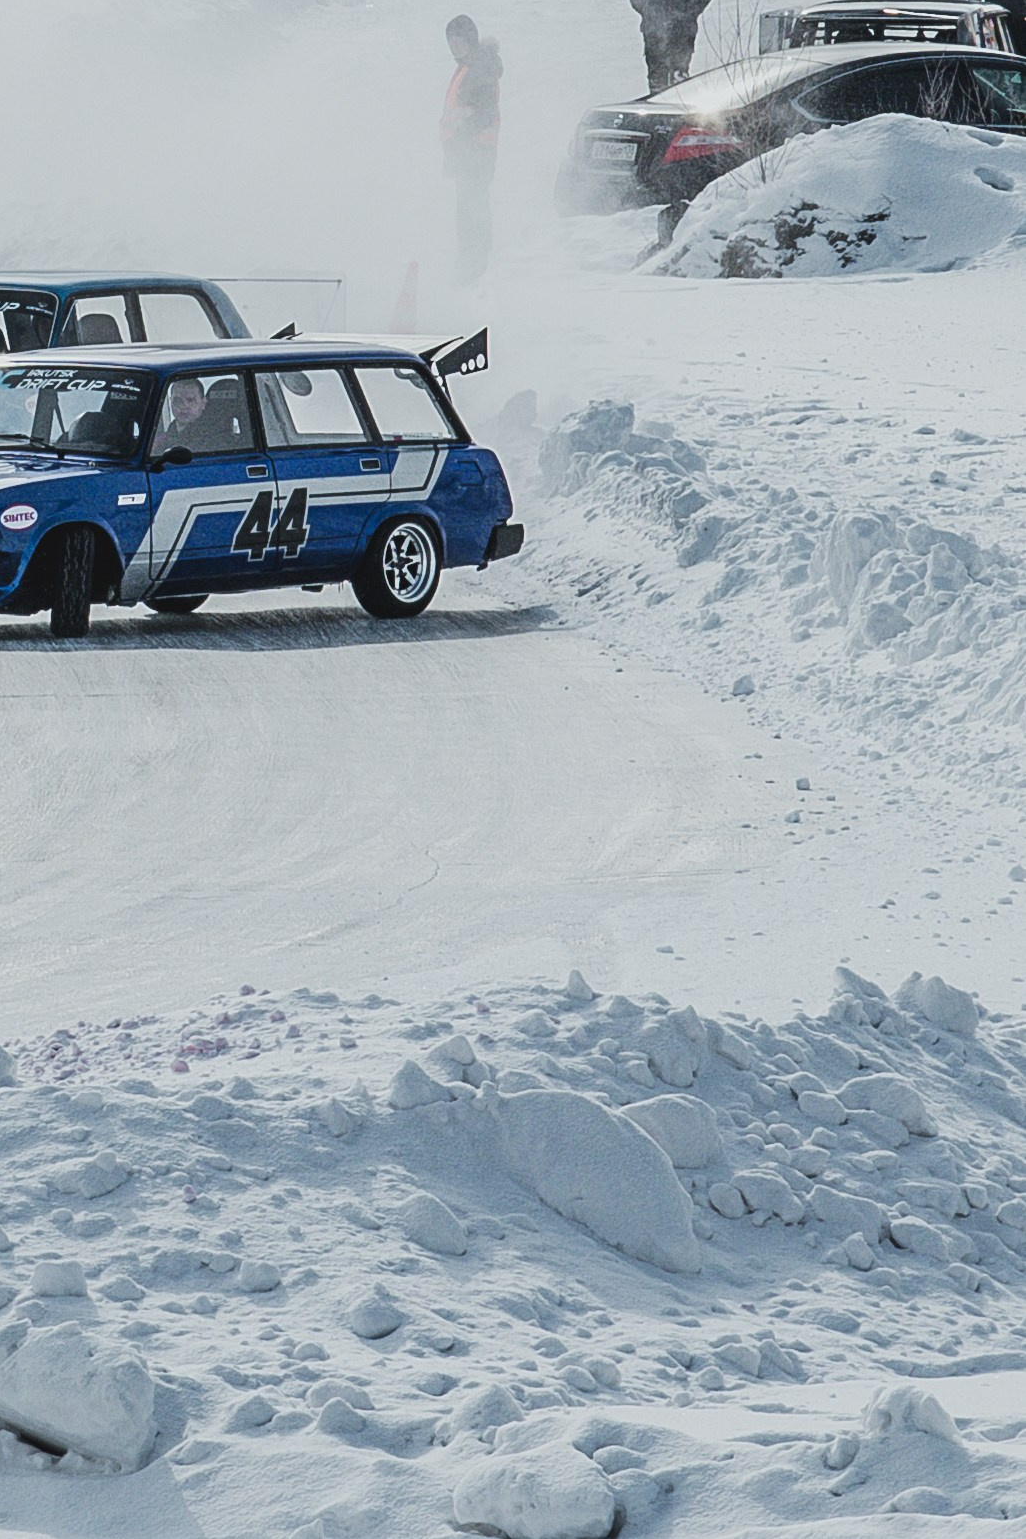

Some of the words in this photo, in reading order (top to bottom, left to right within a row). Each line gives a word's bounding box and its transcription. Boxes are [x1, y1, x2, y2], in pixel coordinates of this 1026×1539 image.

[26, 369, 79, 379] IRKUTSK
[15, 378, 70, 391] DRIFT
[66, 379, 107, 392] CUP
[3, 511, 36, 524] SINTEC
[231, 487, 310, 562] 44
